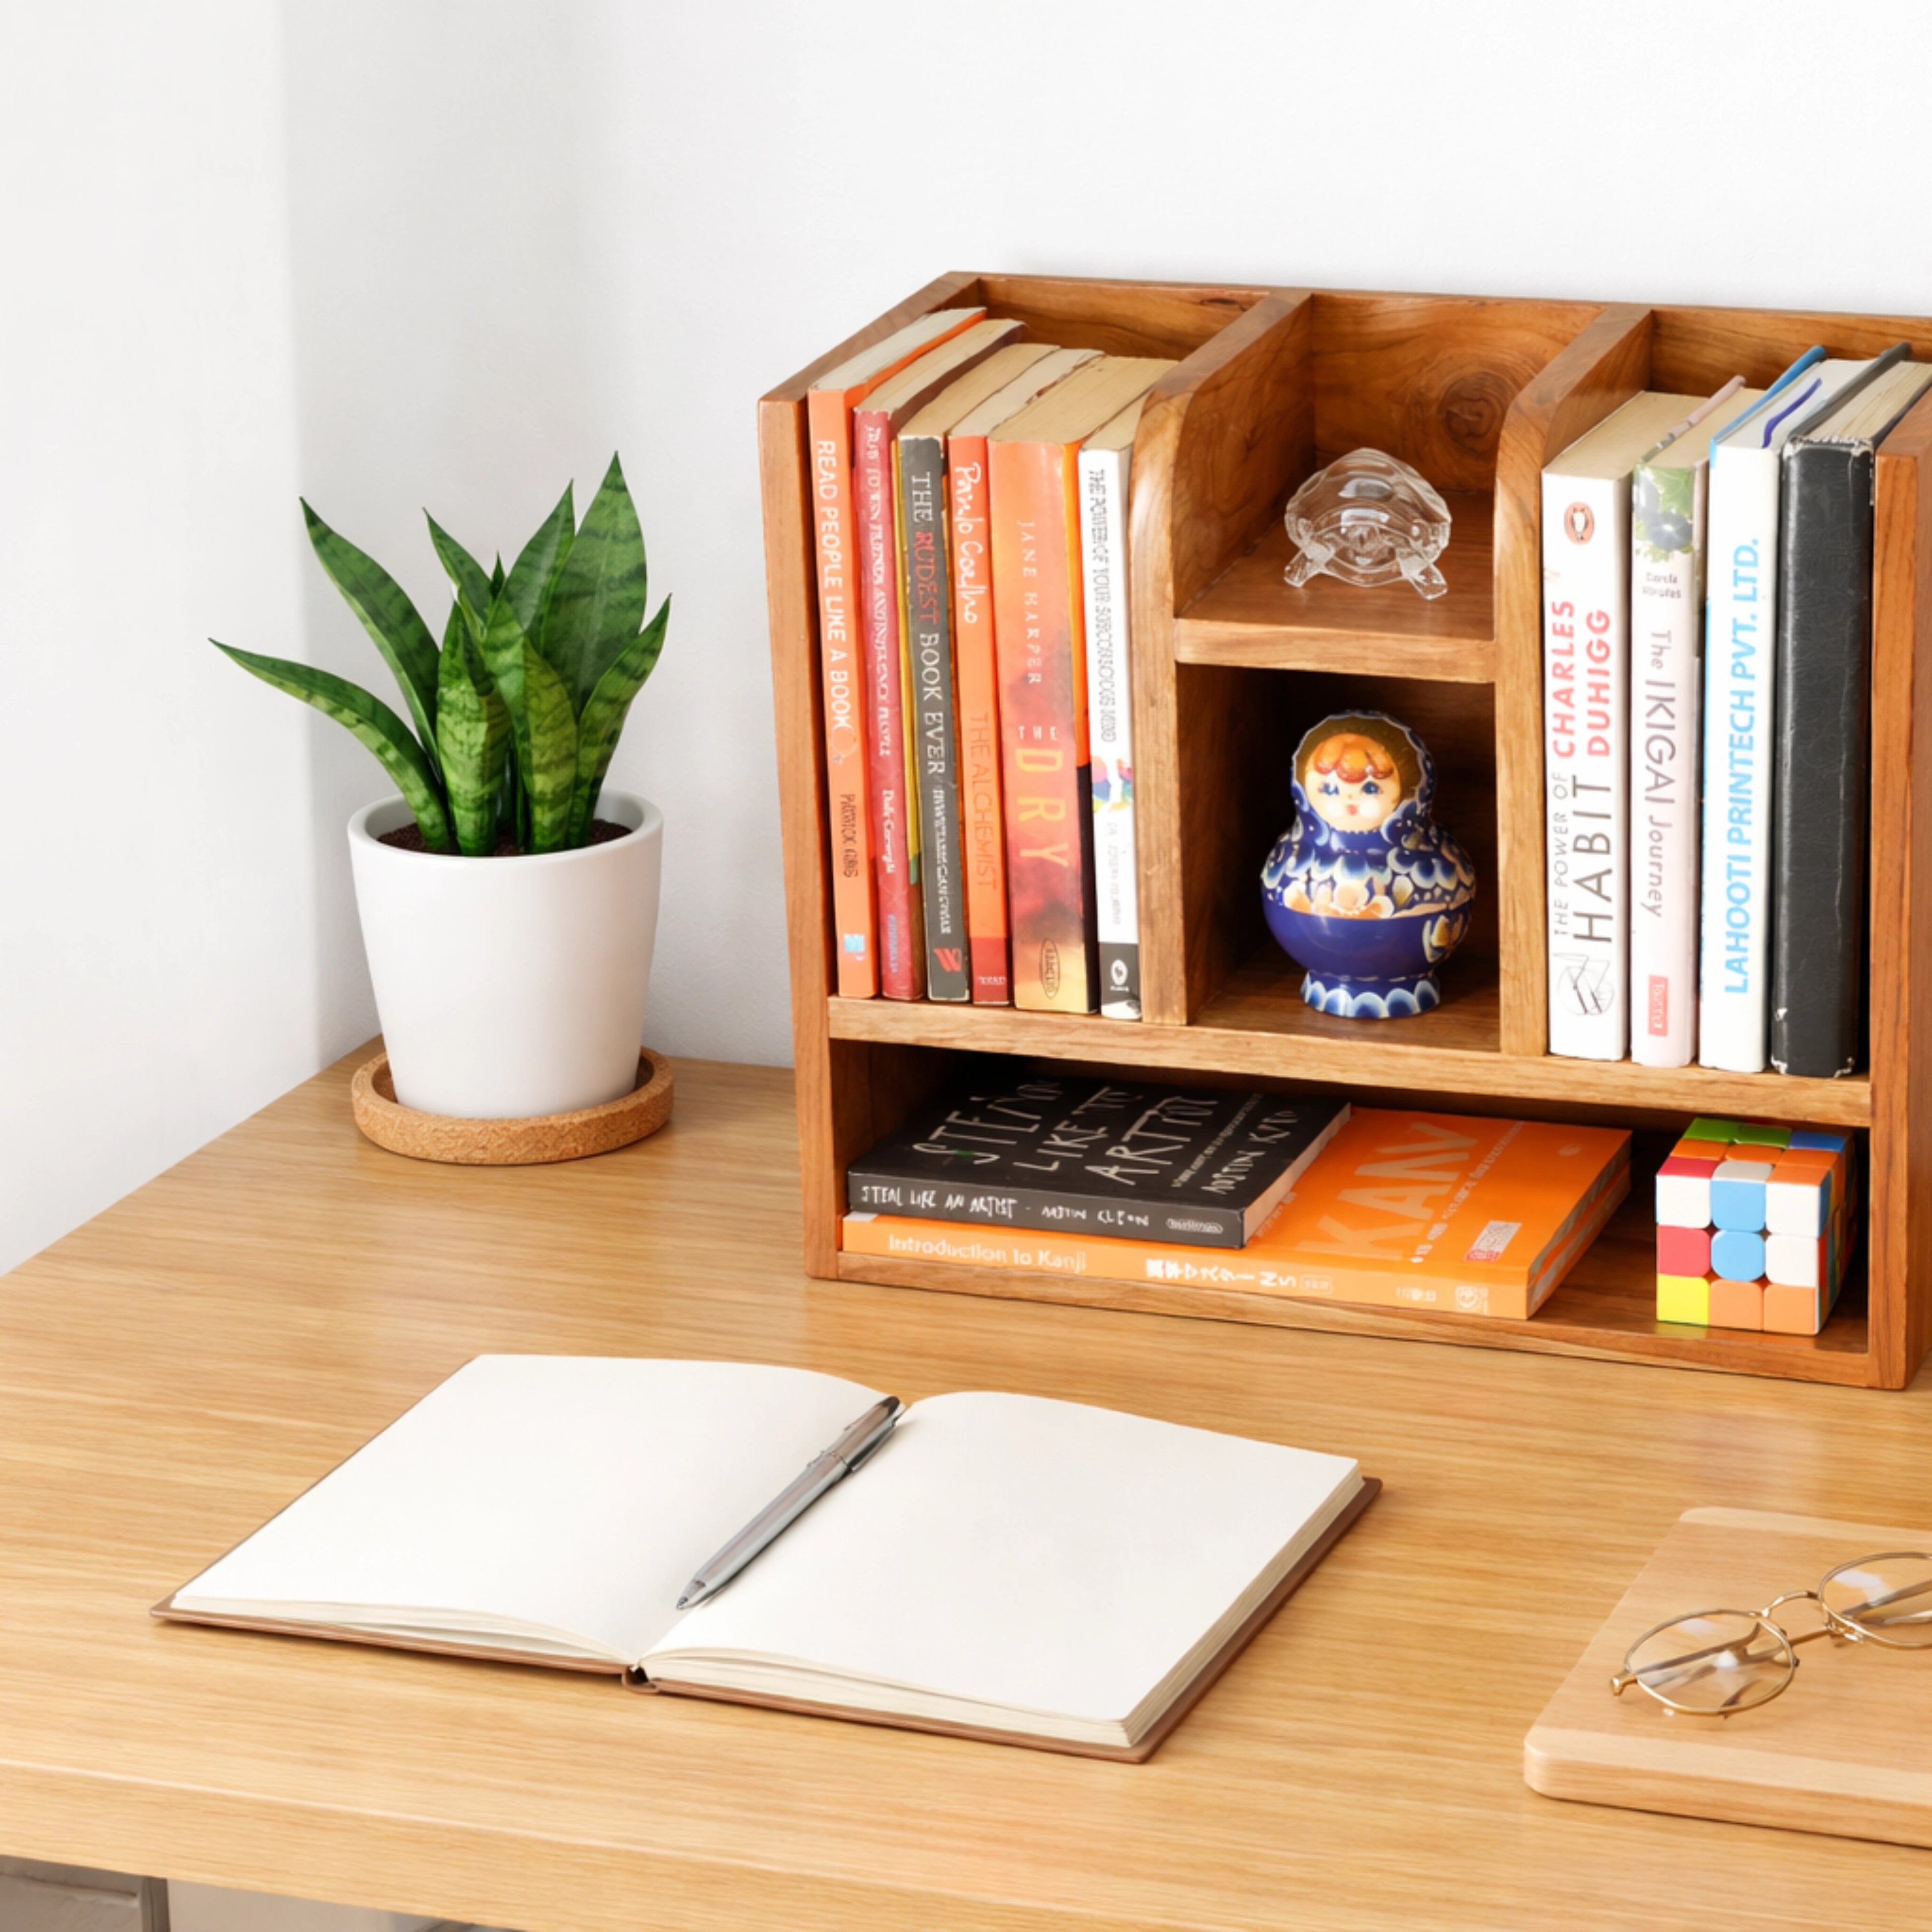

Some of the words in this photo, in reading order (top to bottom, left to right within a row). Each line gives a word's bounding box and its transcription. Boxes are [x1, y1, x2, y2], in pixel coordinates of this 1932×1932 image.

[817, 441, 838, 500] READ
[912, 471, 933, 523] THE
[820, 507, 843, 589] PEOPLE
[914, 531, 940, 623] RUDEST
[1017, 521, 1037, 577] JANE
[1732, 539, 1759, 602] LTD.
[825, 596, 846, 641] LIKE
[1024, 592, 1042, 683] HARPER
[1651, 629, 1672, 670] The
[1730, 613, 1757, 680] PVT.
[830, 648, 848, 662] A
[920, 633, 943, 700] BOOK
[1551, 601, 1575, 758] CHARLES
[1586, 609, 1611, 757] DUHIGG
[830, 670, 853, 729] BOOK
[924, 712, 945, 774] EVER
[970, 711, 990, 759] THE
[1018, 726, 1057, 741] THE
[1645, 679, 1676, 804] IKIGAI
[1552, 773, 1568, 800] OF
[1727, 690, 1755, 846] PRINTECH
[973, 764, 997, 891] ALCHEMIST
[1015, 748, 1069, 867] DRY
[1553, 812, 1568, 887] POWER
[1572, 774, 1613, 943] HABIT
[1640, 814, 1673, 917] Journey
[1554, 899, 1568, 935] THE
[1724, 854, 1751, 994] LAHOOTI
[861, 1185, 903, 1206] STEAL
[889, 1234, 1008, 1263] Introduction
[1038, 1250, 1086, 1274] Kanji
